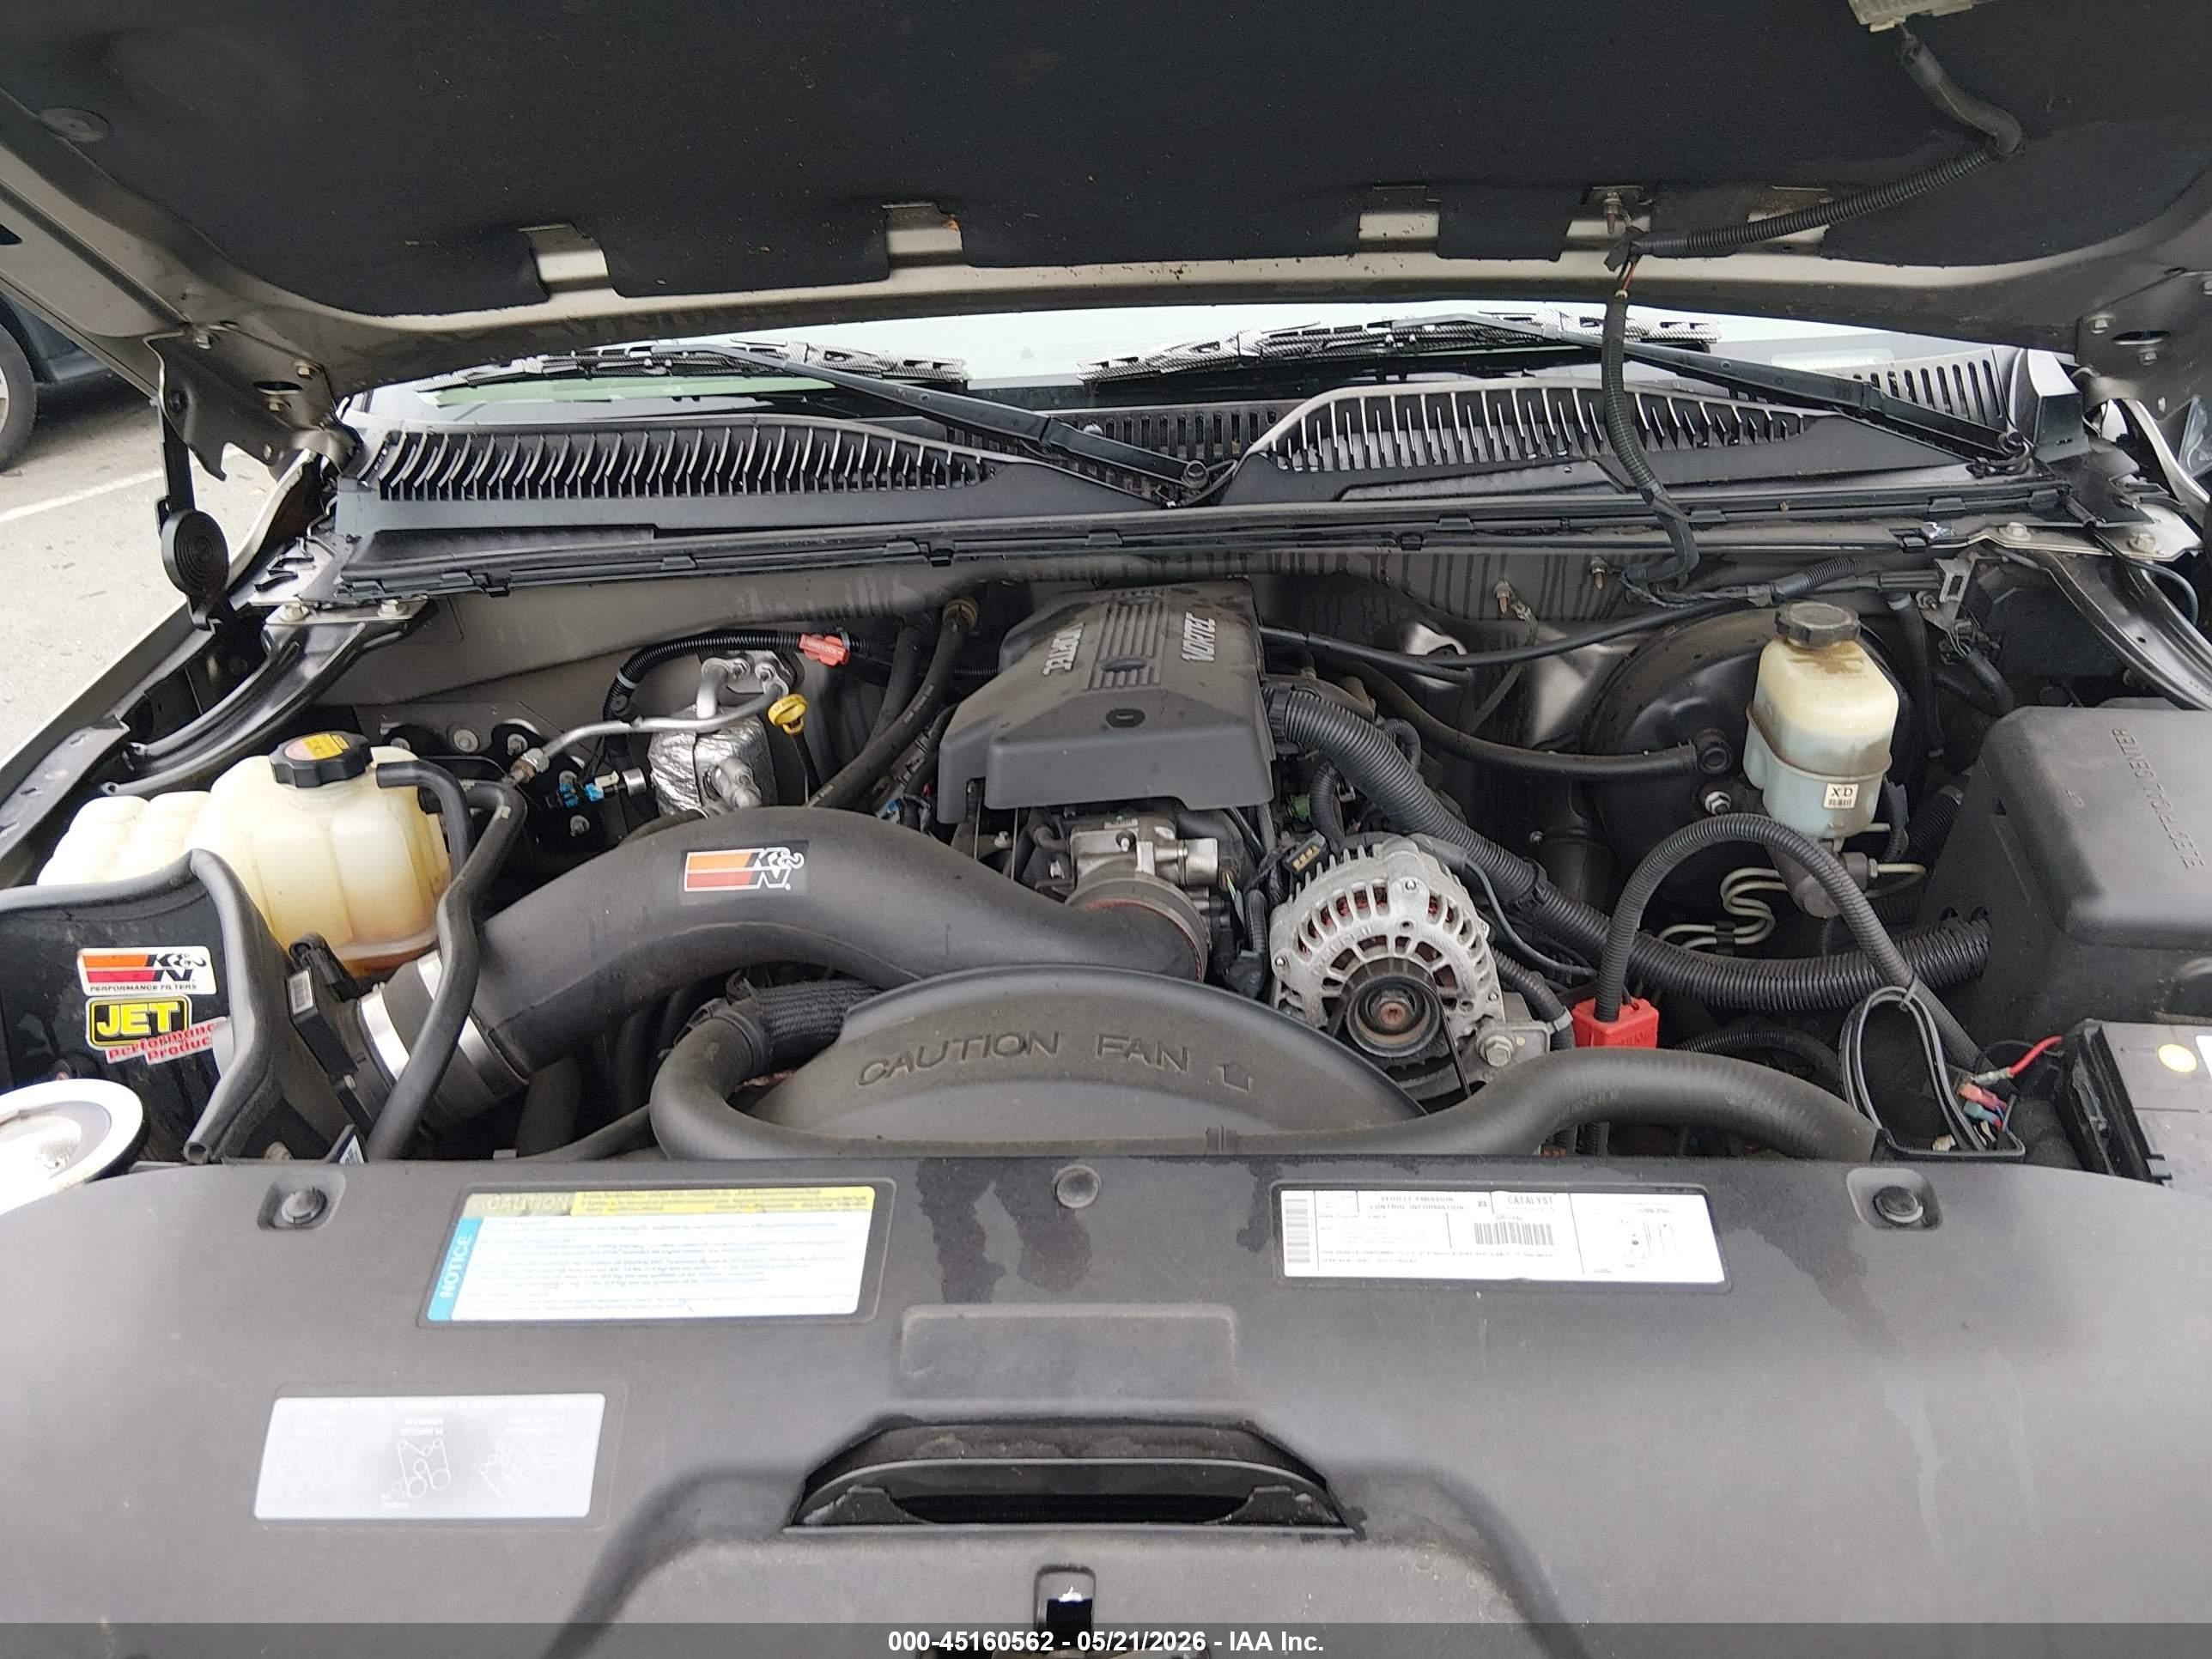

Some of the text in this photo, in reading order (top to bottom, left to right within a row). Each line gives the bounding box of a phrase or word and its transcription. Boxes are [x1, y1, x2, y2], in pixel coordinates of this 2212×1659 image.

[1042, 622, 1085, 676] VORTEC
[1182, 611, 1215, 662] VORTEC
[2110, 727, 2157, 778] CENTER
[90, 985, 158, 994] PERFORMANCE
[95, 1002, 180, 1037] JET
[109, 1022, 217, 1060] performanc
[855, 1029, 1190, 1086] CAUTION FAN
[1507, 1194, 1553, 1206] CATALYST
[438, 1233, 472, 1298] NOTICE
